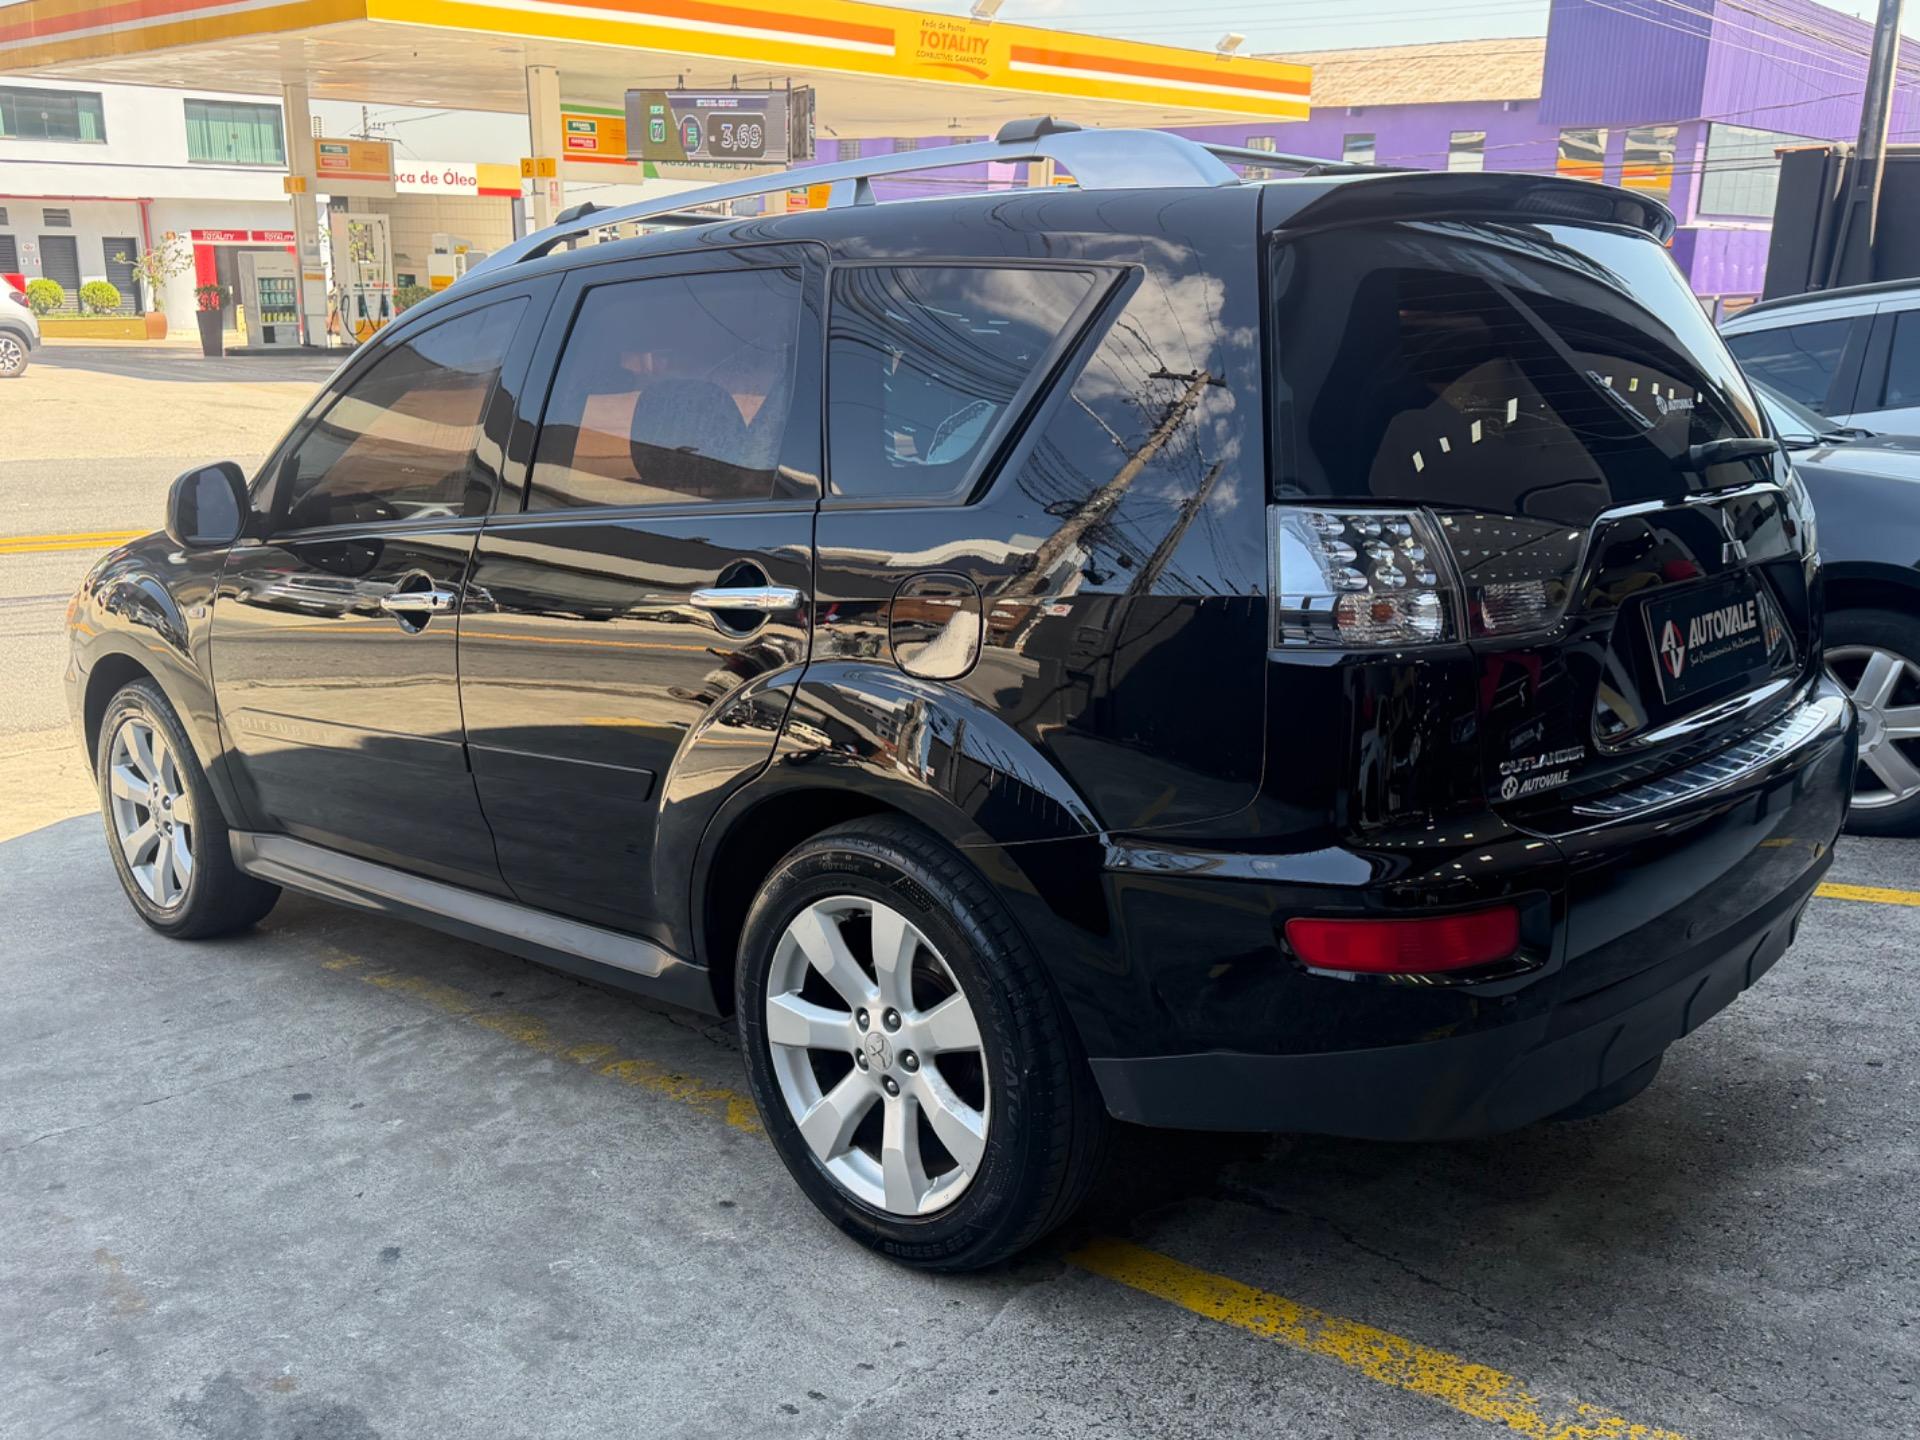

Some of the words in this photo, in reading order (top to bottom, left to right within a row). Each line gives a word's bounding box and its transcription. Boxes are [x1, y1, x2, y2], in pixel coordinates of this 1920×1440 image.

[920, 30, 990, 55] TOTALITY
[721, 124, 762, 152] 3,69
[421, 170, 438, 185] de
[443, 168, 477, 186] Óleo
[524, 161, 532, 173] 2
[541, 161, 546, 173] 1
[1688, 600, 1757, 649] AUTOVALE
[1519, 769, 1570, 794] AUTOVALE
